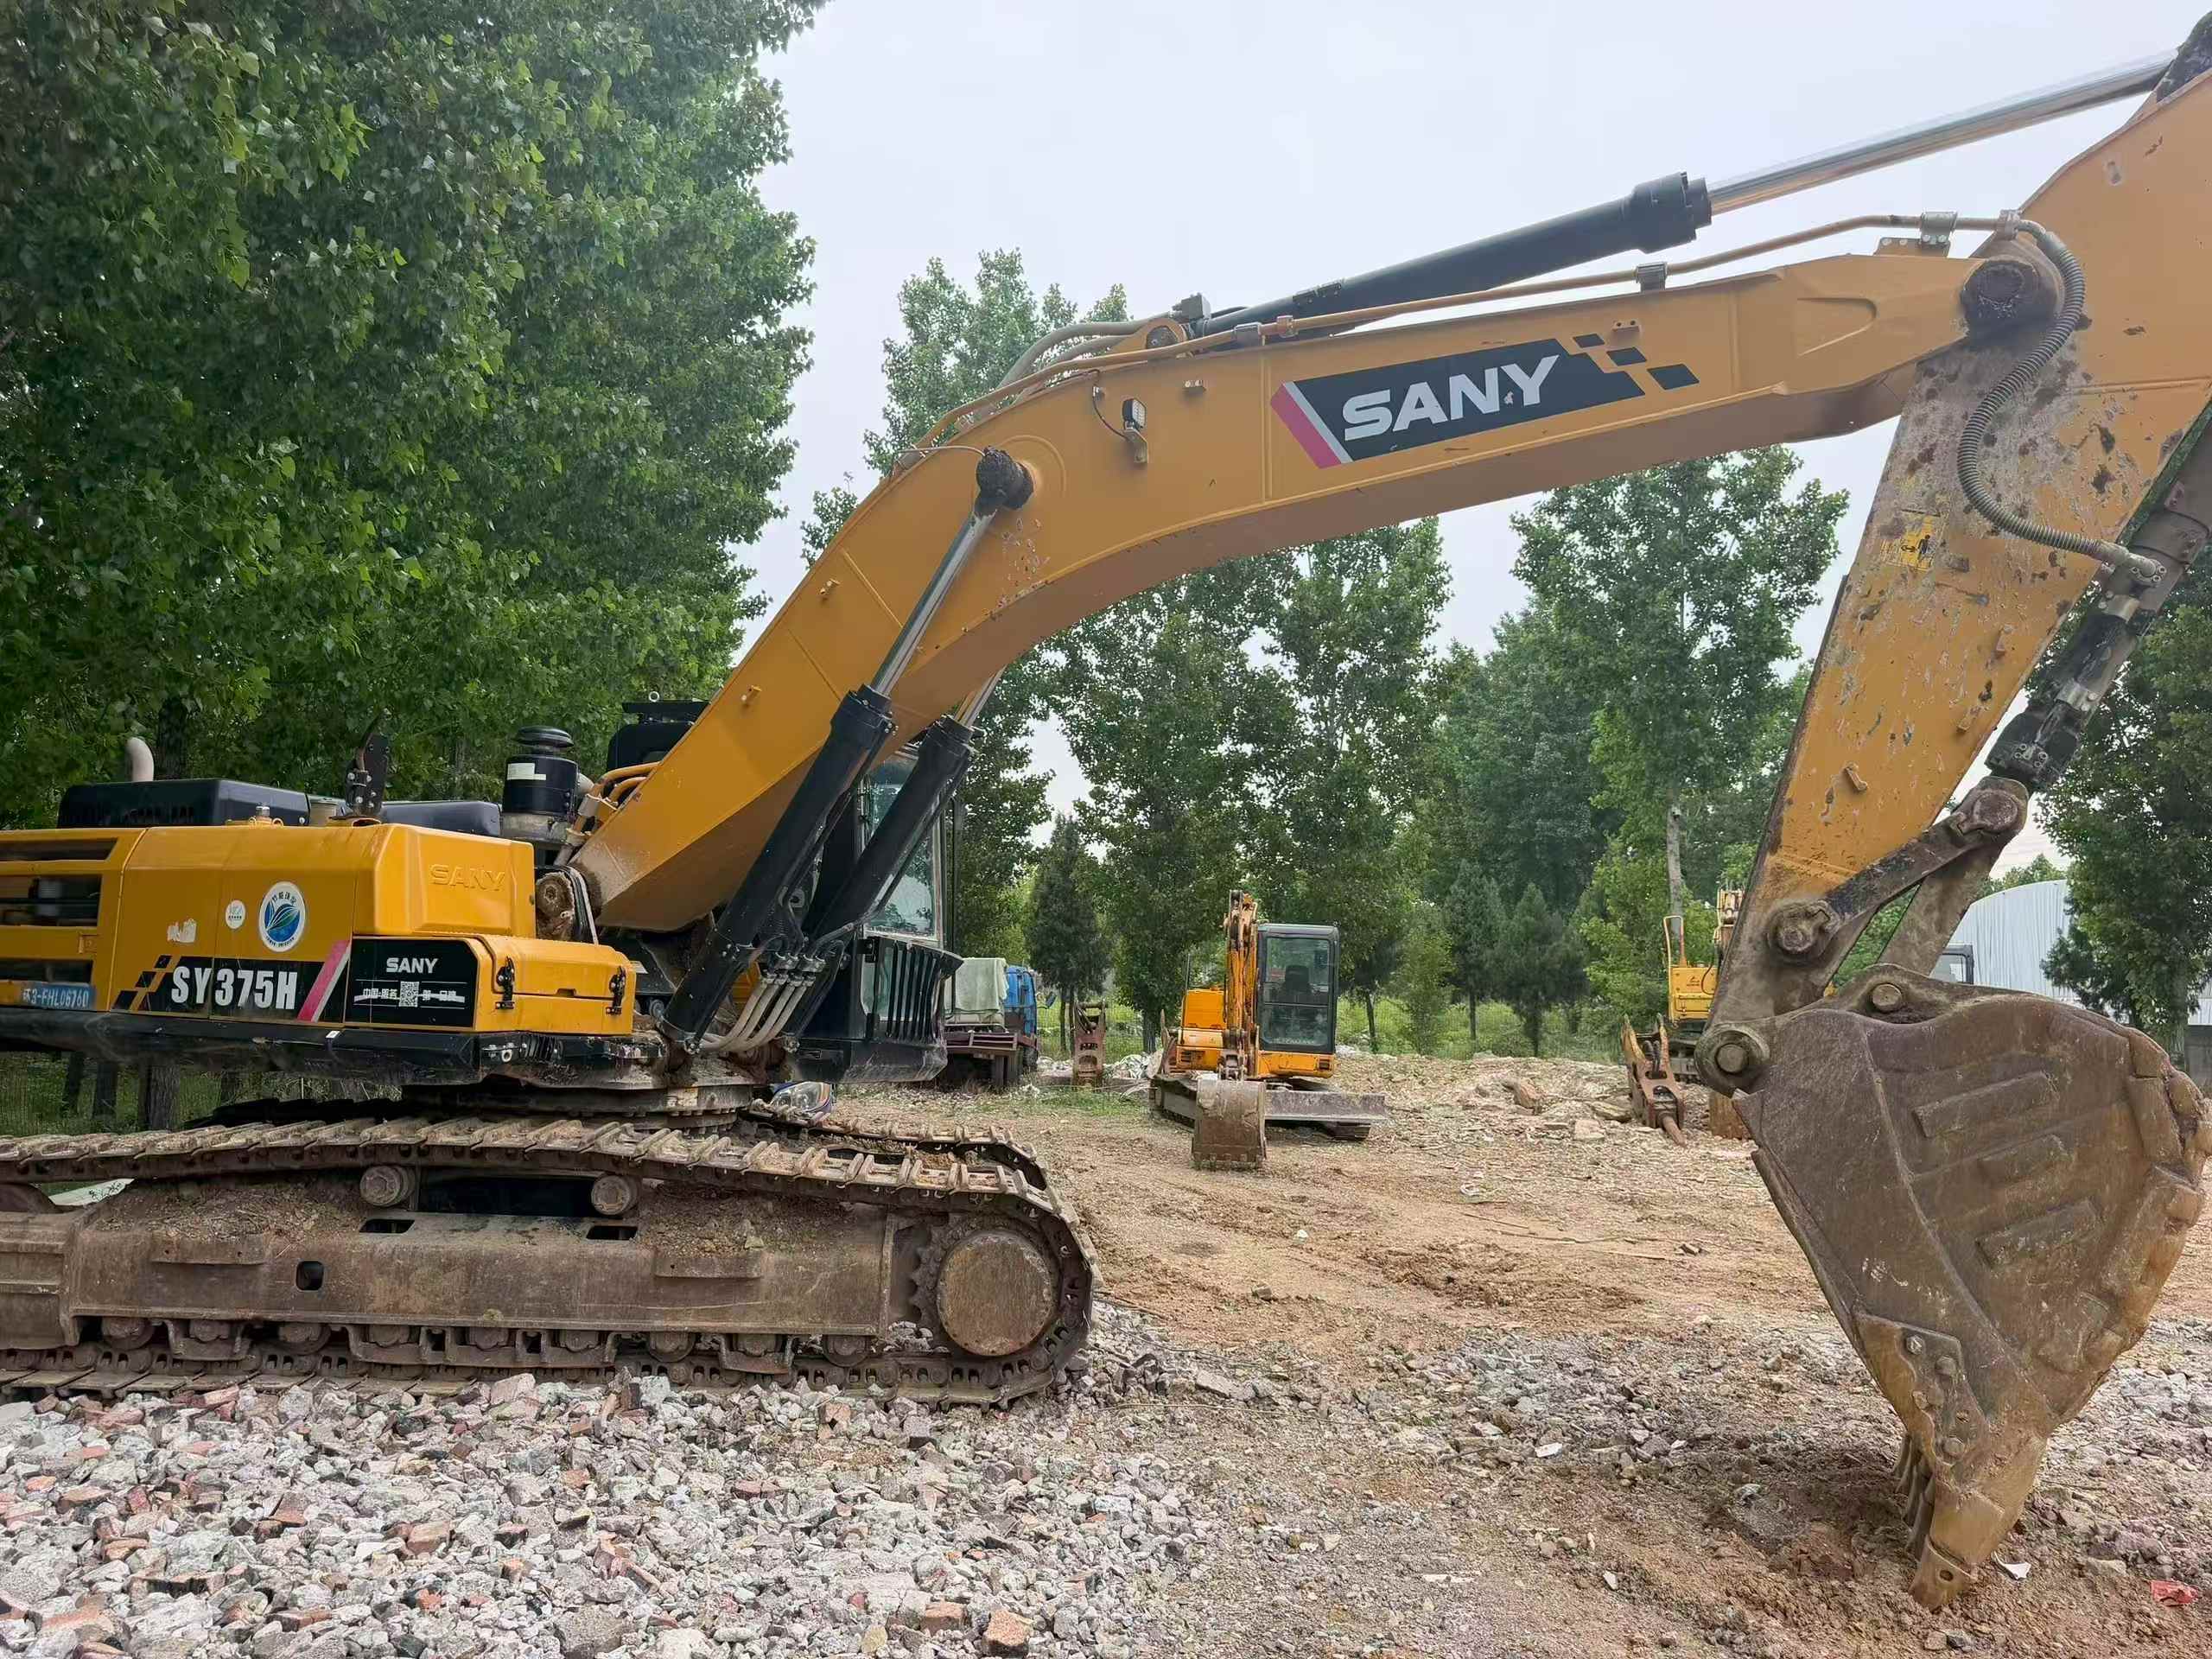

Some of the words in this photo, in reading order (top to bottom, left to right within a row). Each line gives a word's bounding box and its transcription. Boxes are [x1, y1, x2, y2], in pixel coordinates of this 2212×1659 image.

[1342, 355, 1559, 441] SANY
[430, 864, 505, 892] SANY
[385, 957, 439, 974] SANY
[171, 966, 298, 1010] SY375H
